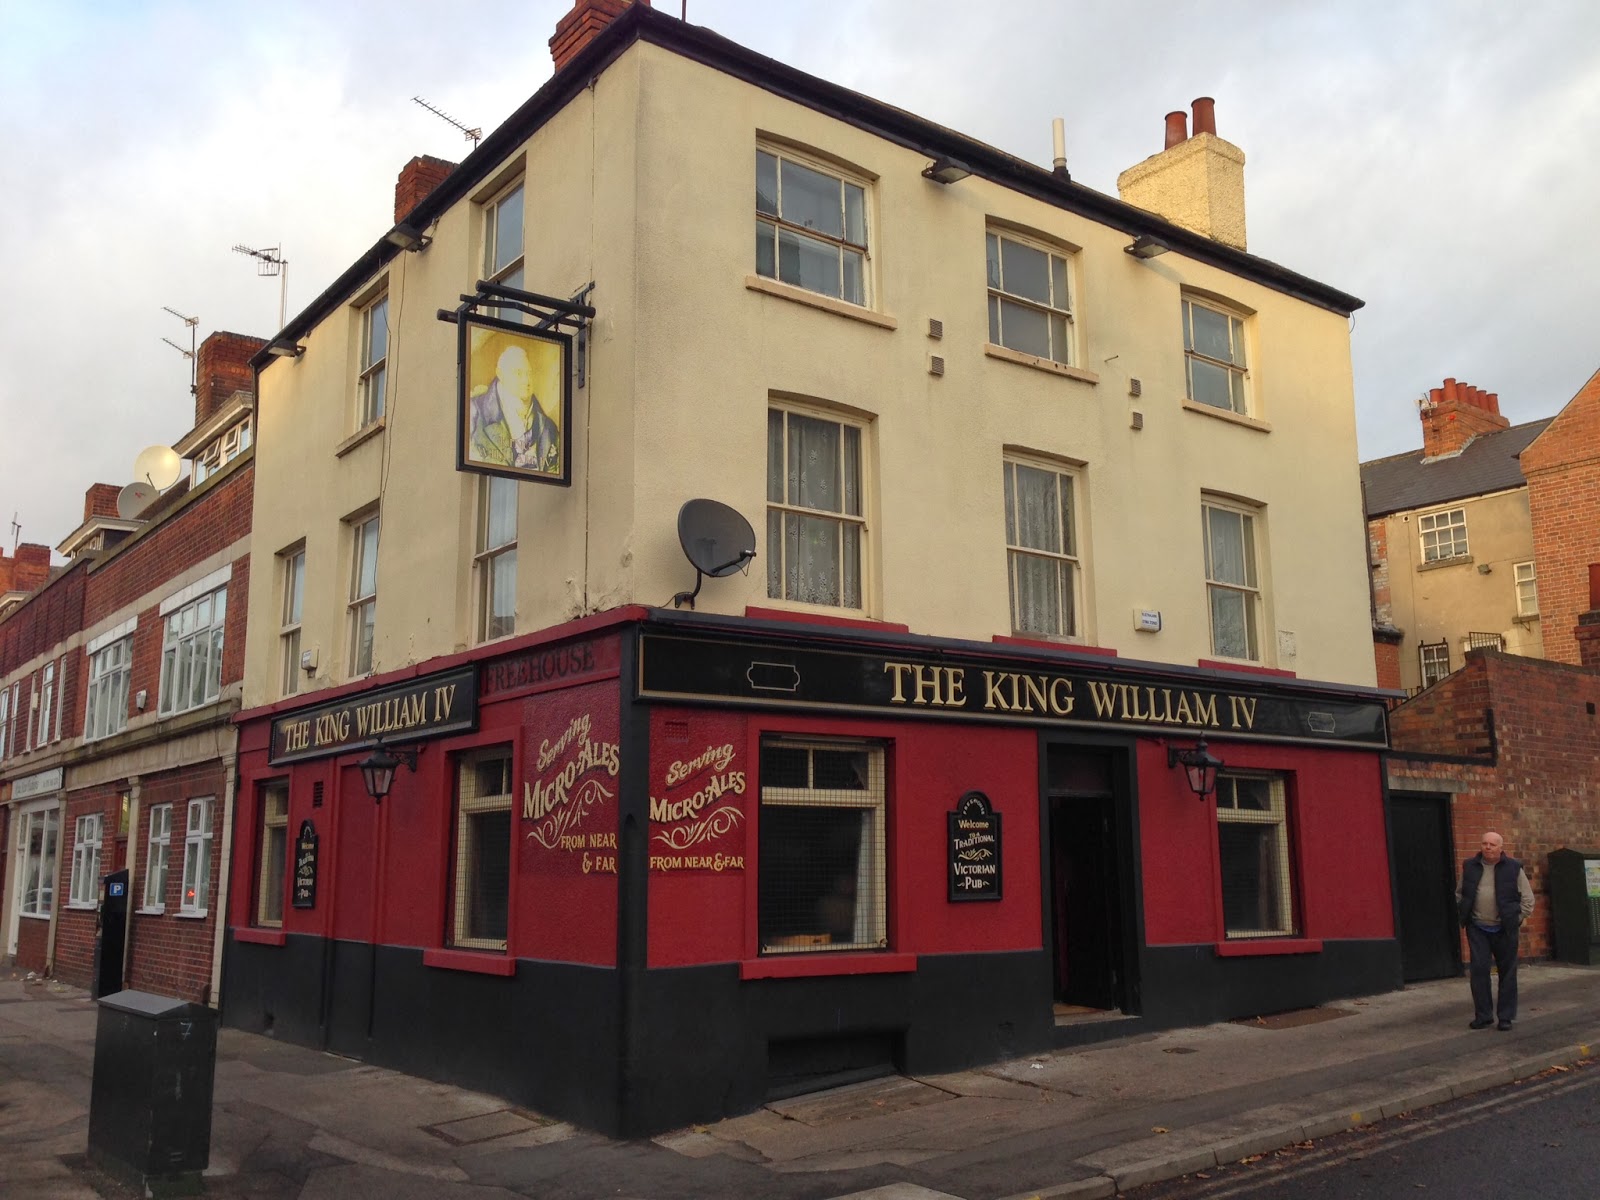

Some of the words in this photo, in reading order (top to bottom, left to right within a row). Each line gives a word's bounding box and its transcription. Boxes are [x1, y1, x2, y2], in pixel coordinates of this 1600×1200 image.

[884, 661, 967, 707] THE
[983, 670, 1075, 715] KING
[1087, 681, 1220, 726] WILLIAM
[1228, 695, 1257, 729] IV
[284, 720, 310, 753] THE
[314, 710, 350, 746] KING
[356, 690, 427, 738] WILLIAM
[433, 684, 456, 722] IV
[537, 713, 591, 772] Serving
[665, 744, 736, 786] Serving
[958, 819, 990, 829] Welcome
[561, 834, 586, 852] FROM
[590, 833, 617, 849] NEAR
[953, 834, 995, 850] TRADITIONAL
[596, 856, 617, 873] FAR
[650, 856, 682, 872] FROM
[953, 862, 996, 876] VICTORIAN
